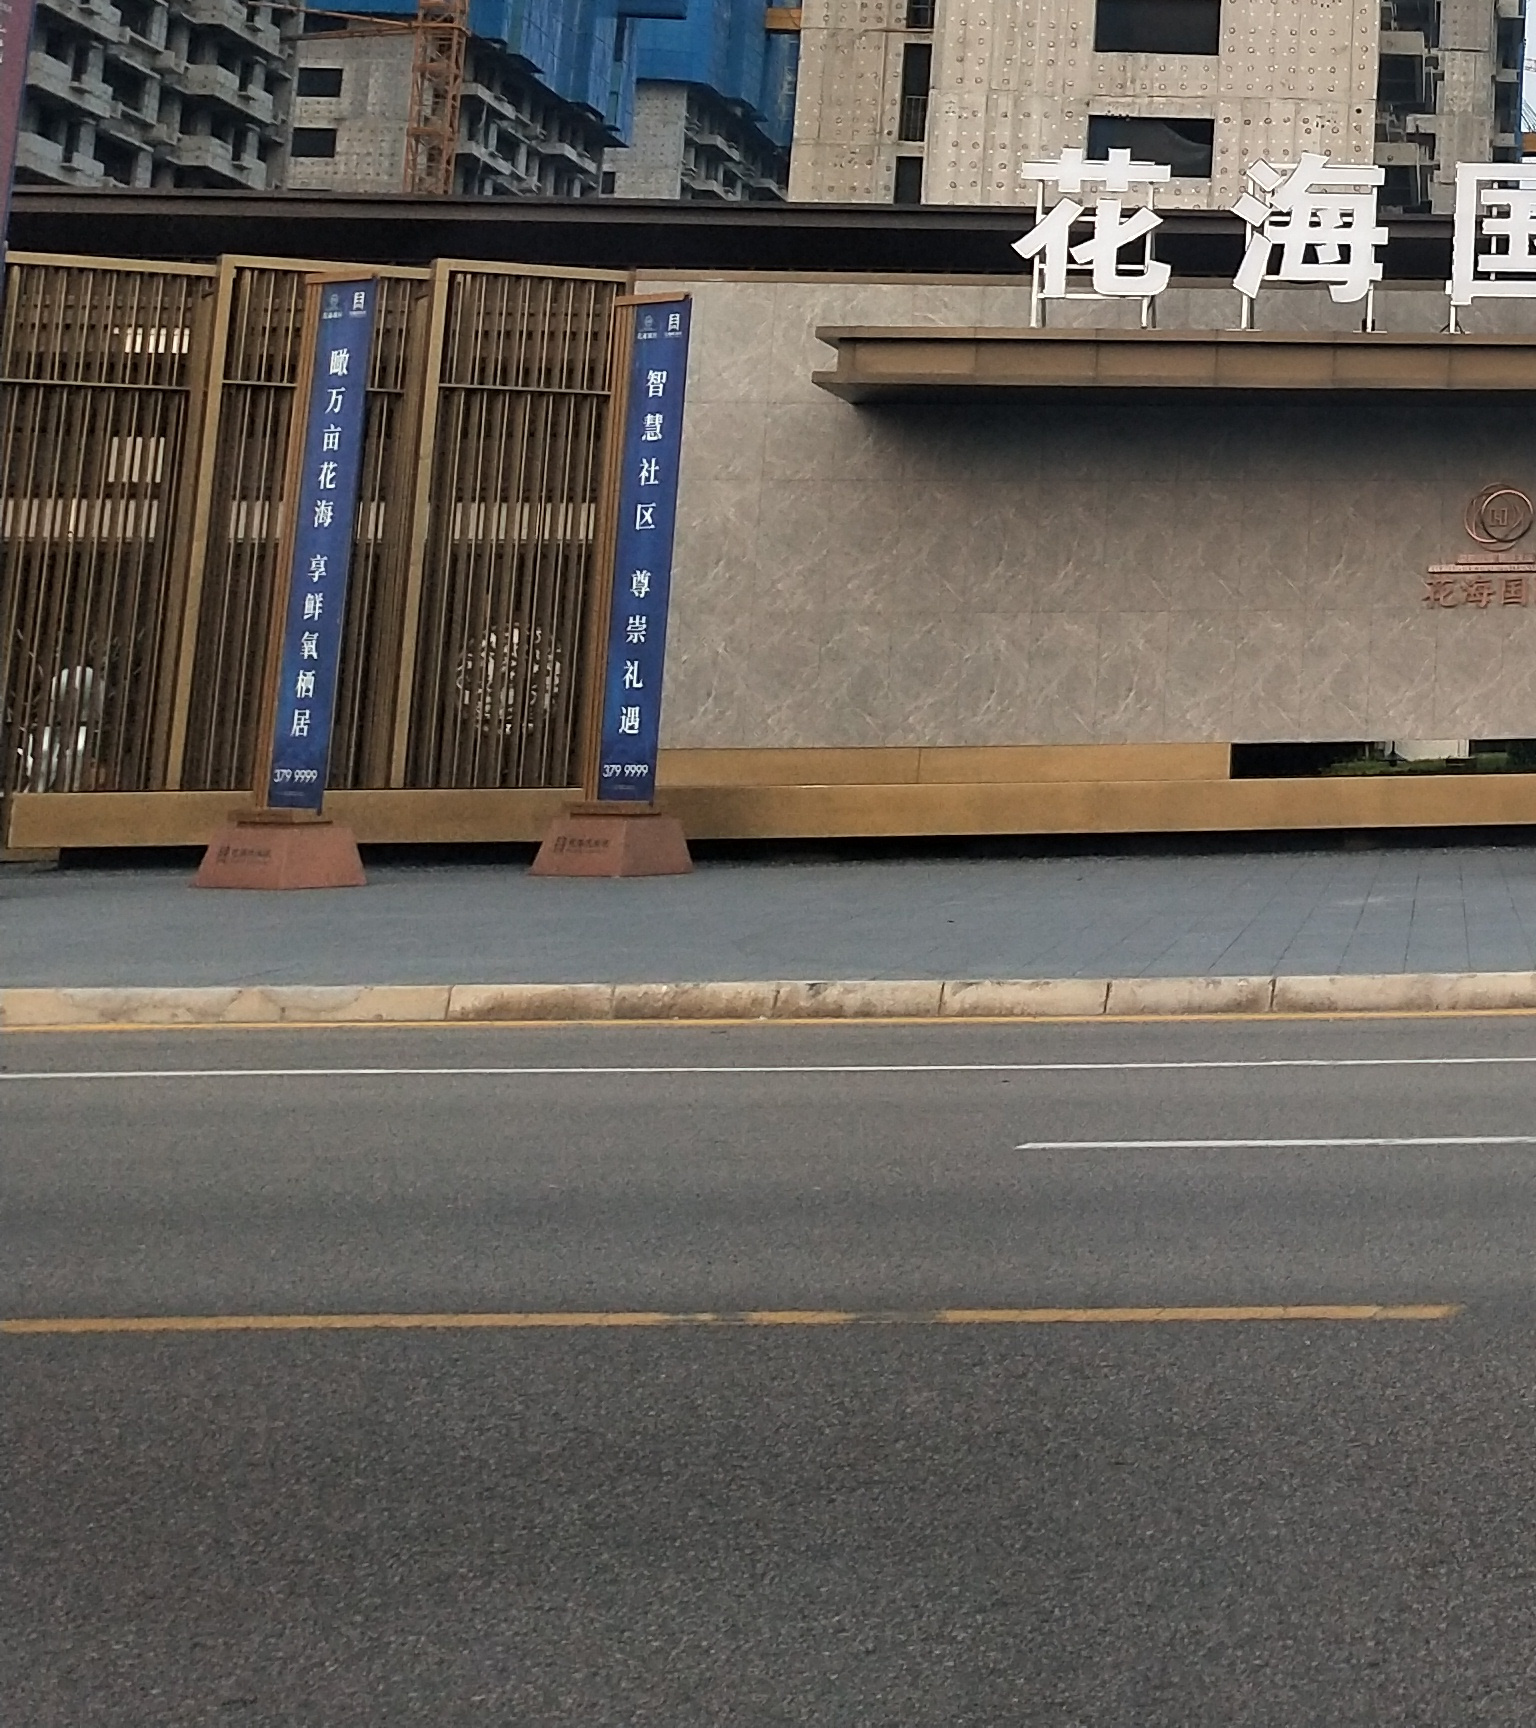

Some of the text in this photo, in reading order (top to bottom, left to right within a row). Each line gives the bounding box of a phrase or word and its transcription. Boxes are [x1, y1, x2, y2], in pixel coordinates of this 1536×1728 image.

[313, 348, 350, 529] 瞰万亩花海
[634, 369, 668, 532] 智慧社区
[290, 553, 327, 738] 享鲜氧栖居
[618, 569, 652, 737] 尊崇礼遇
